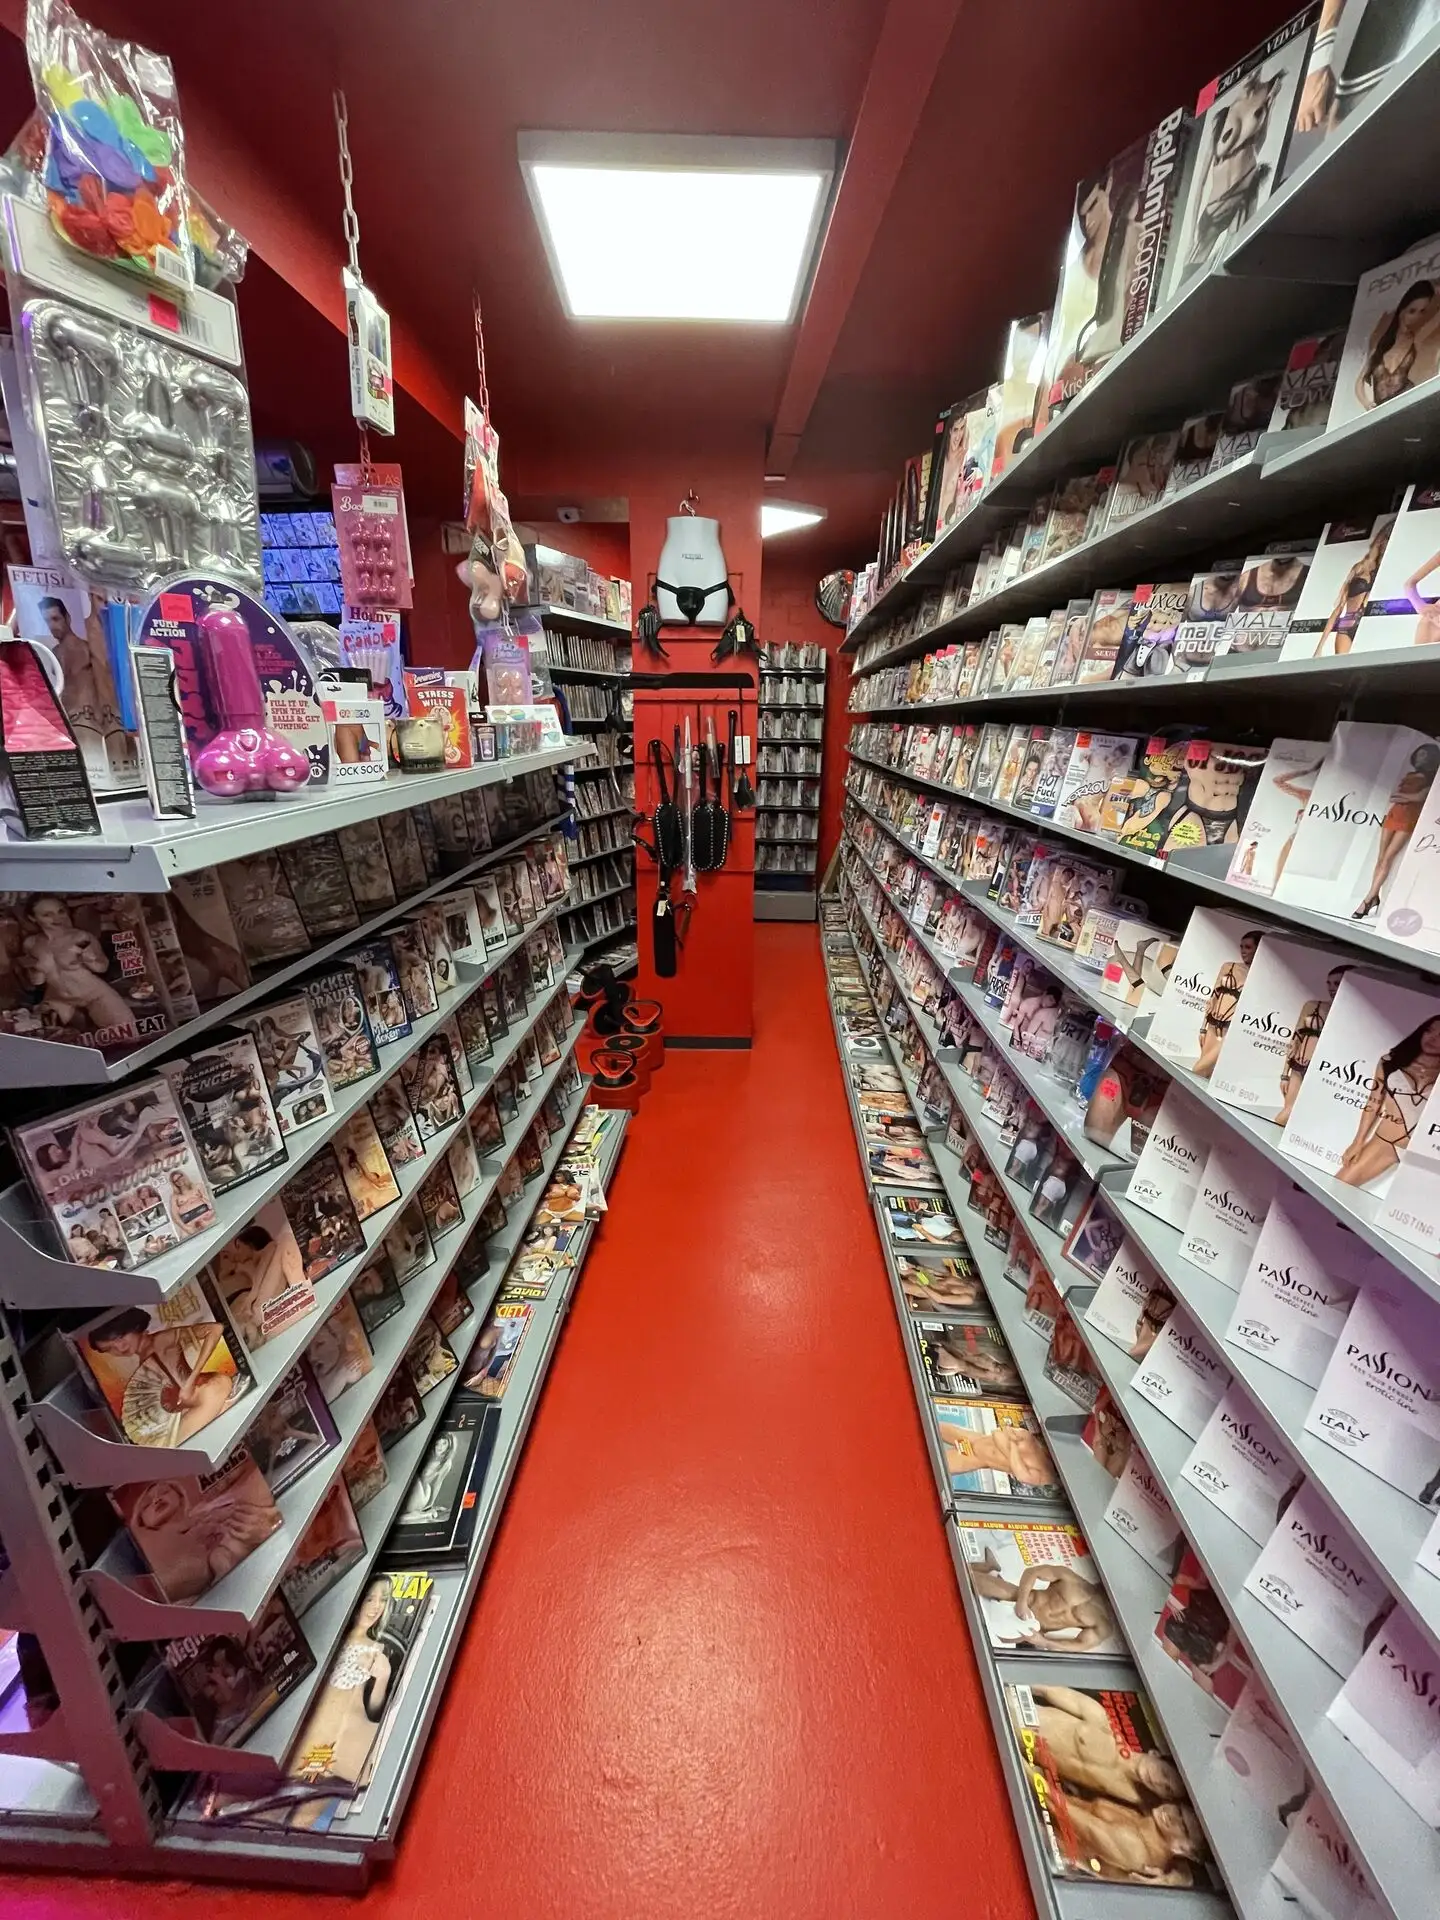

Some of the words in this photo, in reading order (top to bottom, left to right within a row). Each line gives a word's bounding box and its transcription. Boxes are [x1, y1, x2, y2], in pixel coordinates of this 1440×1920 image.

[150, 628, 186, 638] ACTION
[152, 619, 179, 629] PUMP
[270, 700, 286, 708] FILL
[416, 690, 455, 699] STRESS
[422, 698, 453, 708] WILLIE
[271, 707, 289, 716] SPIN
[290, 708, 306, 716] THE
[272, 715, 295, 723] BALLS
[305, 715, 321, 723] GET
[360, 763, 385, 775] SOCK
[1040, 774, 1060, 787] HOT
[1036, 786, 1056, 798] Fuck
[1308, 791, 1387, 828] PASSION
[115, 940, 137, 952] MEN
[1181, 998, 1206, 1013] erotic
[135, 1014, 166, 1036] EAT
[1253, 1040, 1286, 1057] erotic
[1333, 1091, 1374, 1113] erotic
[58, 1168, 96, 1187] Dirty
[1133, 1183, 1163, 1197] ITALY
[1203, 1187, 1256, 1224] PASSION
[1187, 1241, 1220, 1258] ITALY
[1115, 1265, 1149, 1294] PASSIO
[1257, 1262, 1329, 1306] PASSION
[1237, 1324, 1281, 1344] ITALY
[1346, 1343, 1432, 1400] PASSION
[1141, 1375, 1173, 1395] ITALY
[1319, 1413, 1370, 1440] ITALY
[1220, 1413, 1280, 1466] PASSION
[1192, 1464, 1230, 1490] ITALY
[1111, 1510, 1140, 1533] ITALY
[1290, 1519, 1365, 1588] PASSION
[1259, 1576, 1305, 1609] ITALY
[1378, 1643, 1440, 1717] PASSI
